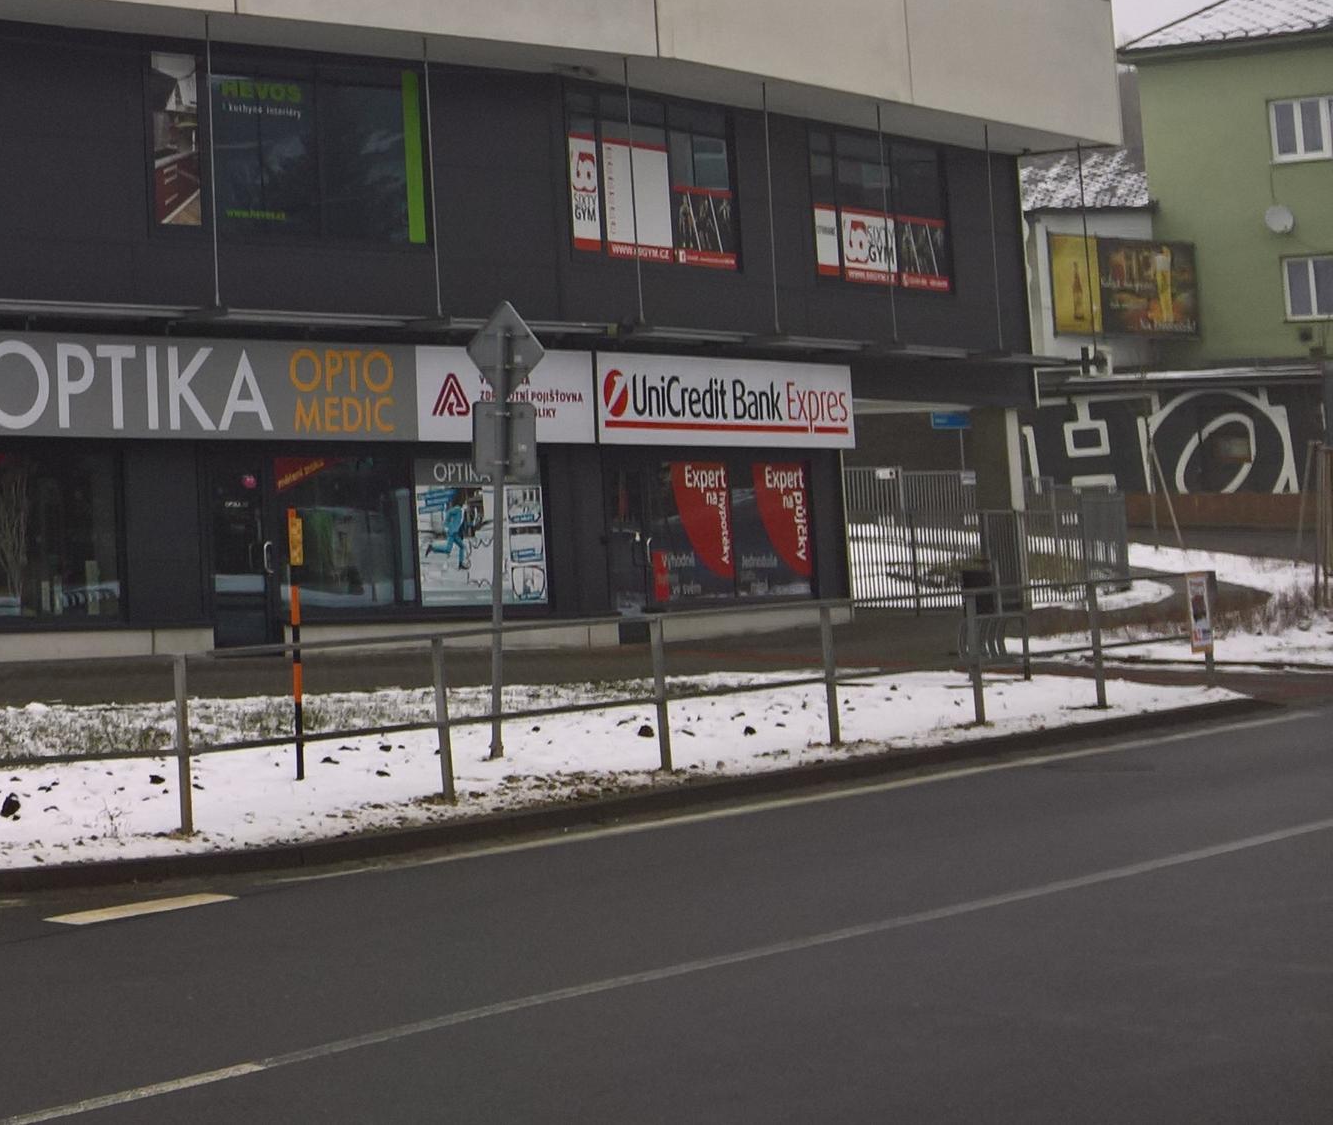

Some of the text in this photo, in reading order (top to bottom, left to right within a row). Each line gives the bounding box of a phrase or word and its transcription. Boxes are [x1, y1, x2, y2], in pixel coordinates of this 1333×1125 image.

[574, 207, 597, 223] GYM
[289, 348, 395, 393] OPTO
[294, 396, 396, 433] MEDIC
[632, 373, 848, 434] UniCredit Bank Expres
[685, 465, 726, 493] Expert
[765, 465, 804, 493] Expert
[706, 491, 718, 505] na
[783, 494, 794, 509] na
